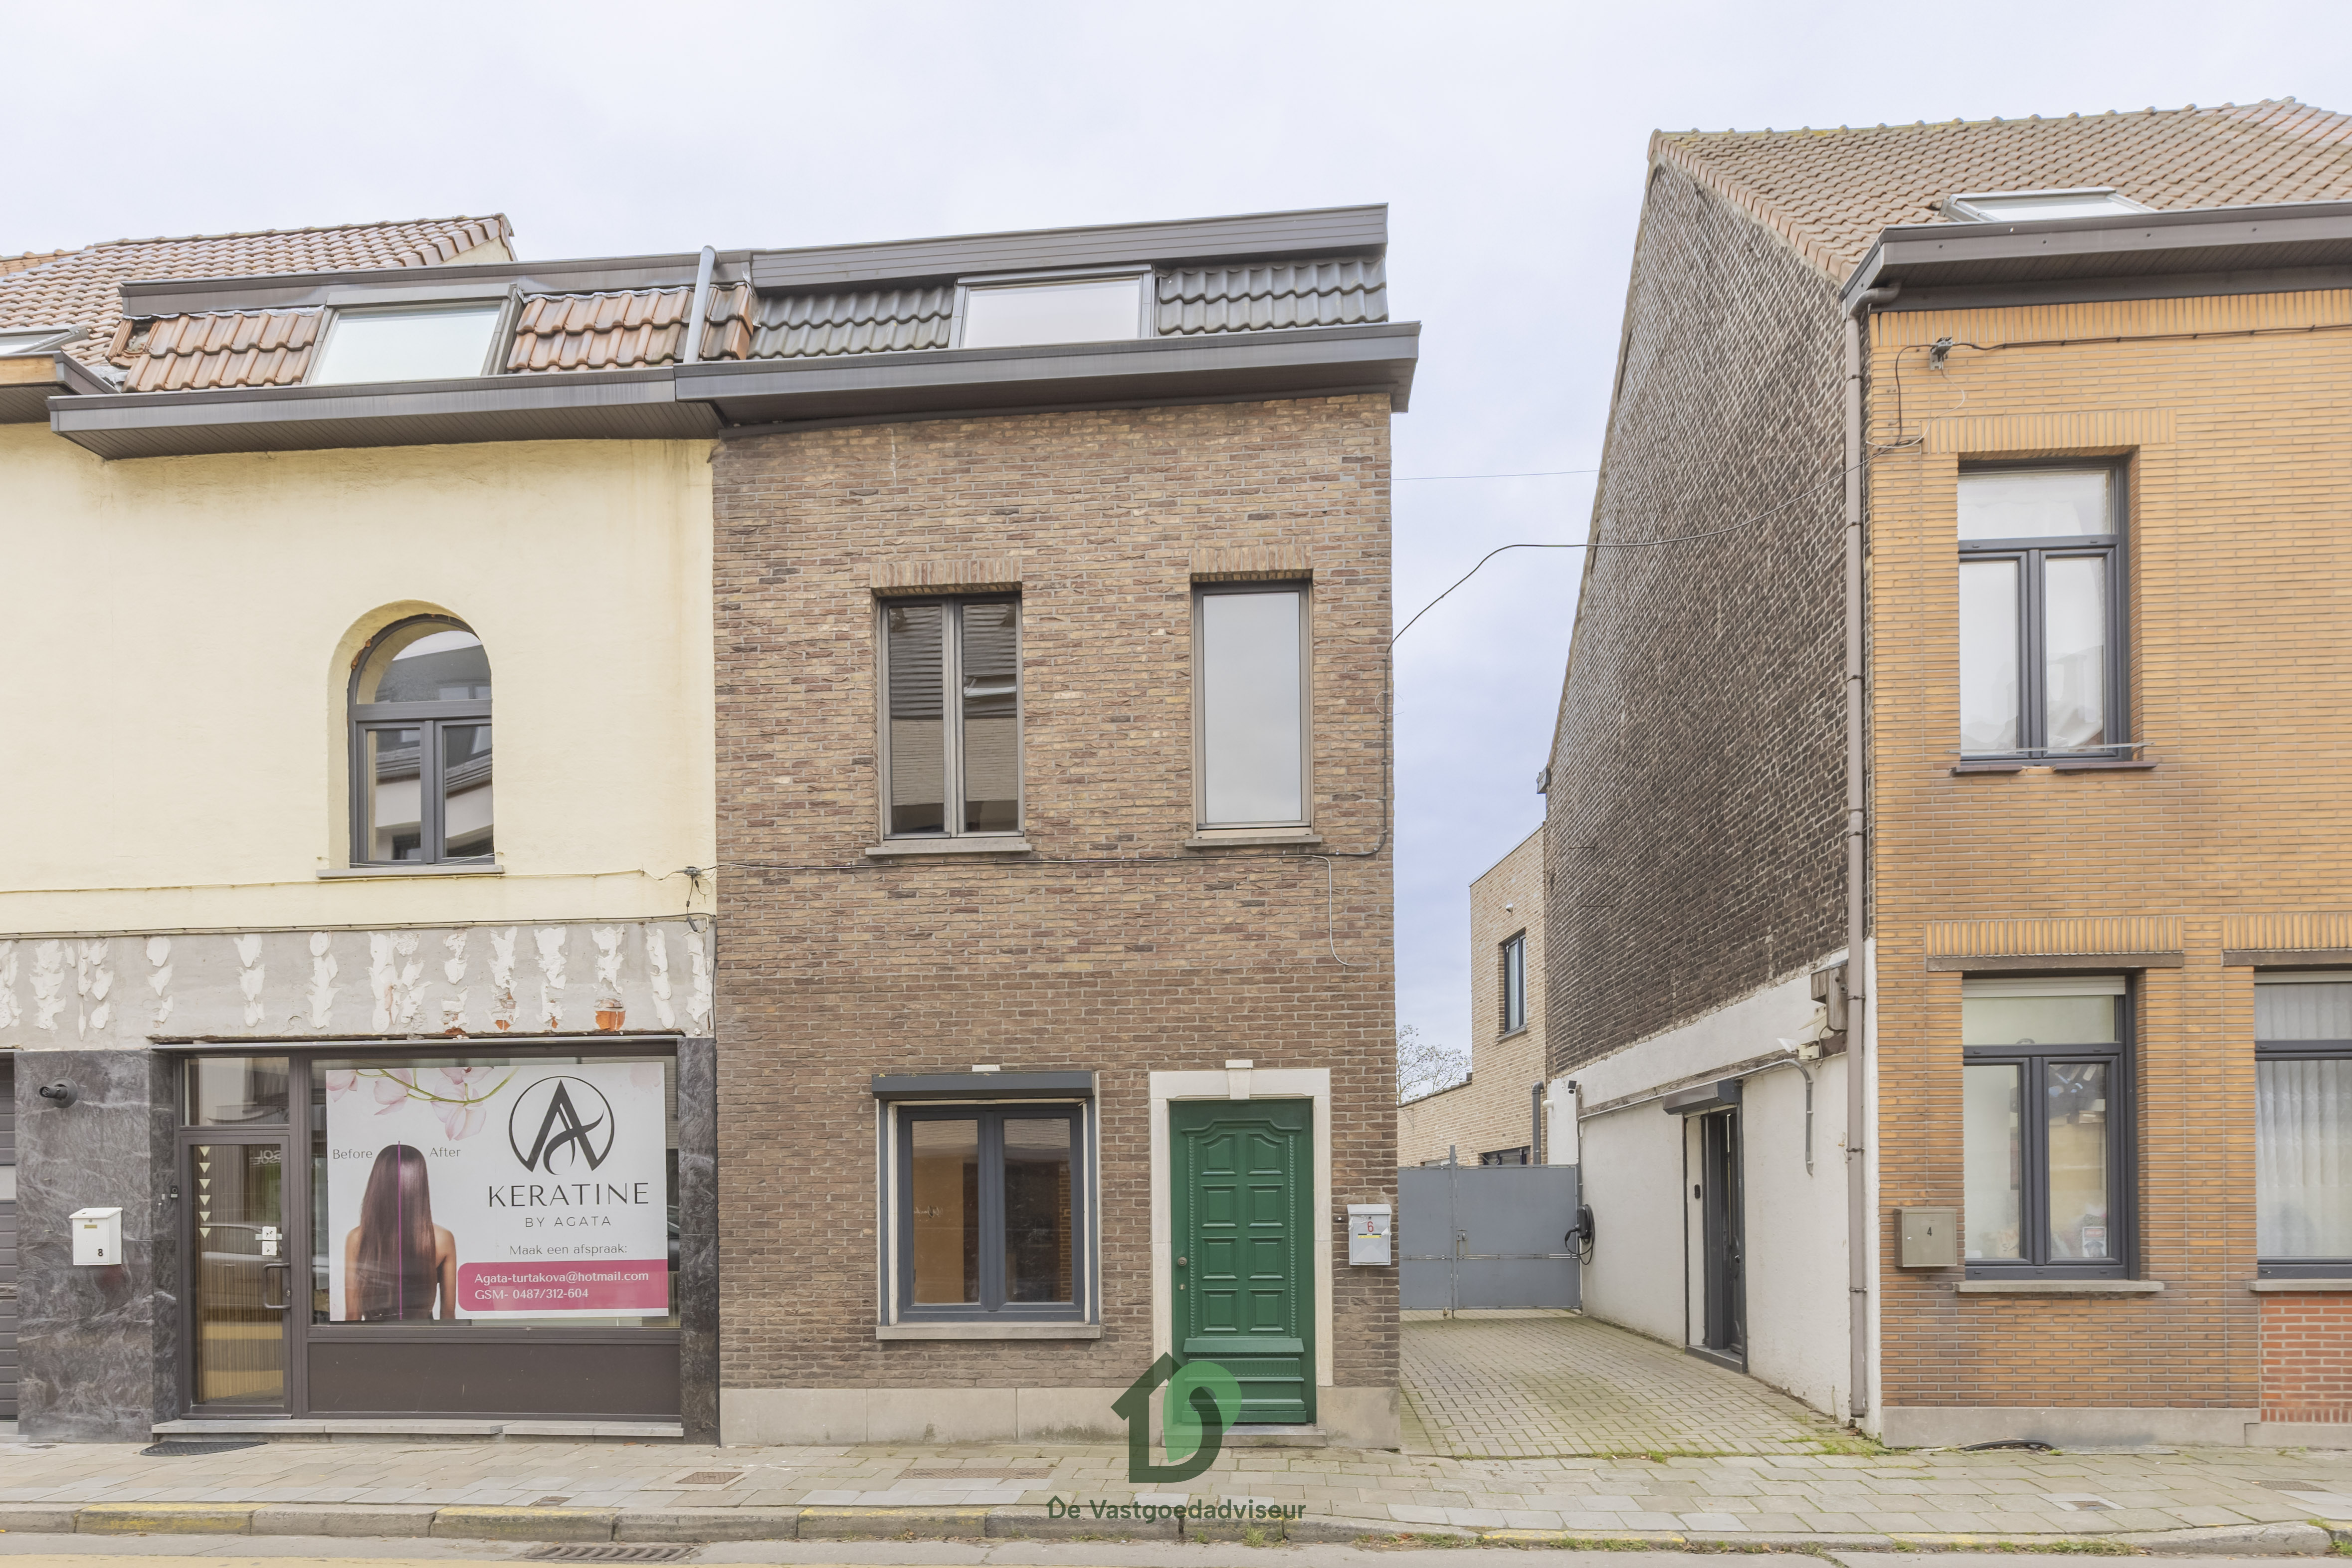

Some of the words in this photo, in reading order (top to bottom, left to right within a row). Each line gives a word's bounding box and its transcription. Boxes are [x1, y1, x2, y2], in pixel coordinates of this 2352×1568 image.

[333, 1149, 373, 1159] Before
[429, 1147, 461, 1158] After
[489, 1182, 649, 1207] KERATINE
[525, 1217, 545, 1228] BY
[554, 1216, 611, 1227] AGATA
[1368, 1221, 1374, 1232] 6
[1927, 1227, 1933, 1236] 4
[98, 1248, 103, 1257] 8
[510, 1245, 543, 1255] Maak
[547, 1246, 569, 1255] een
[574, 1243, 627, 1257] afspraak:
[474, 1271, 649, 1286] Agata-turtakova@hotmail.com
[475, 1290, 509, 1300] GSM-
[512, 1288, 589, 1300] 0487/312-604
